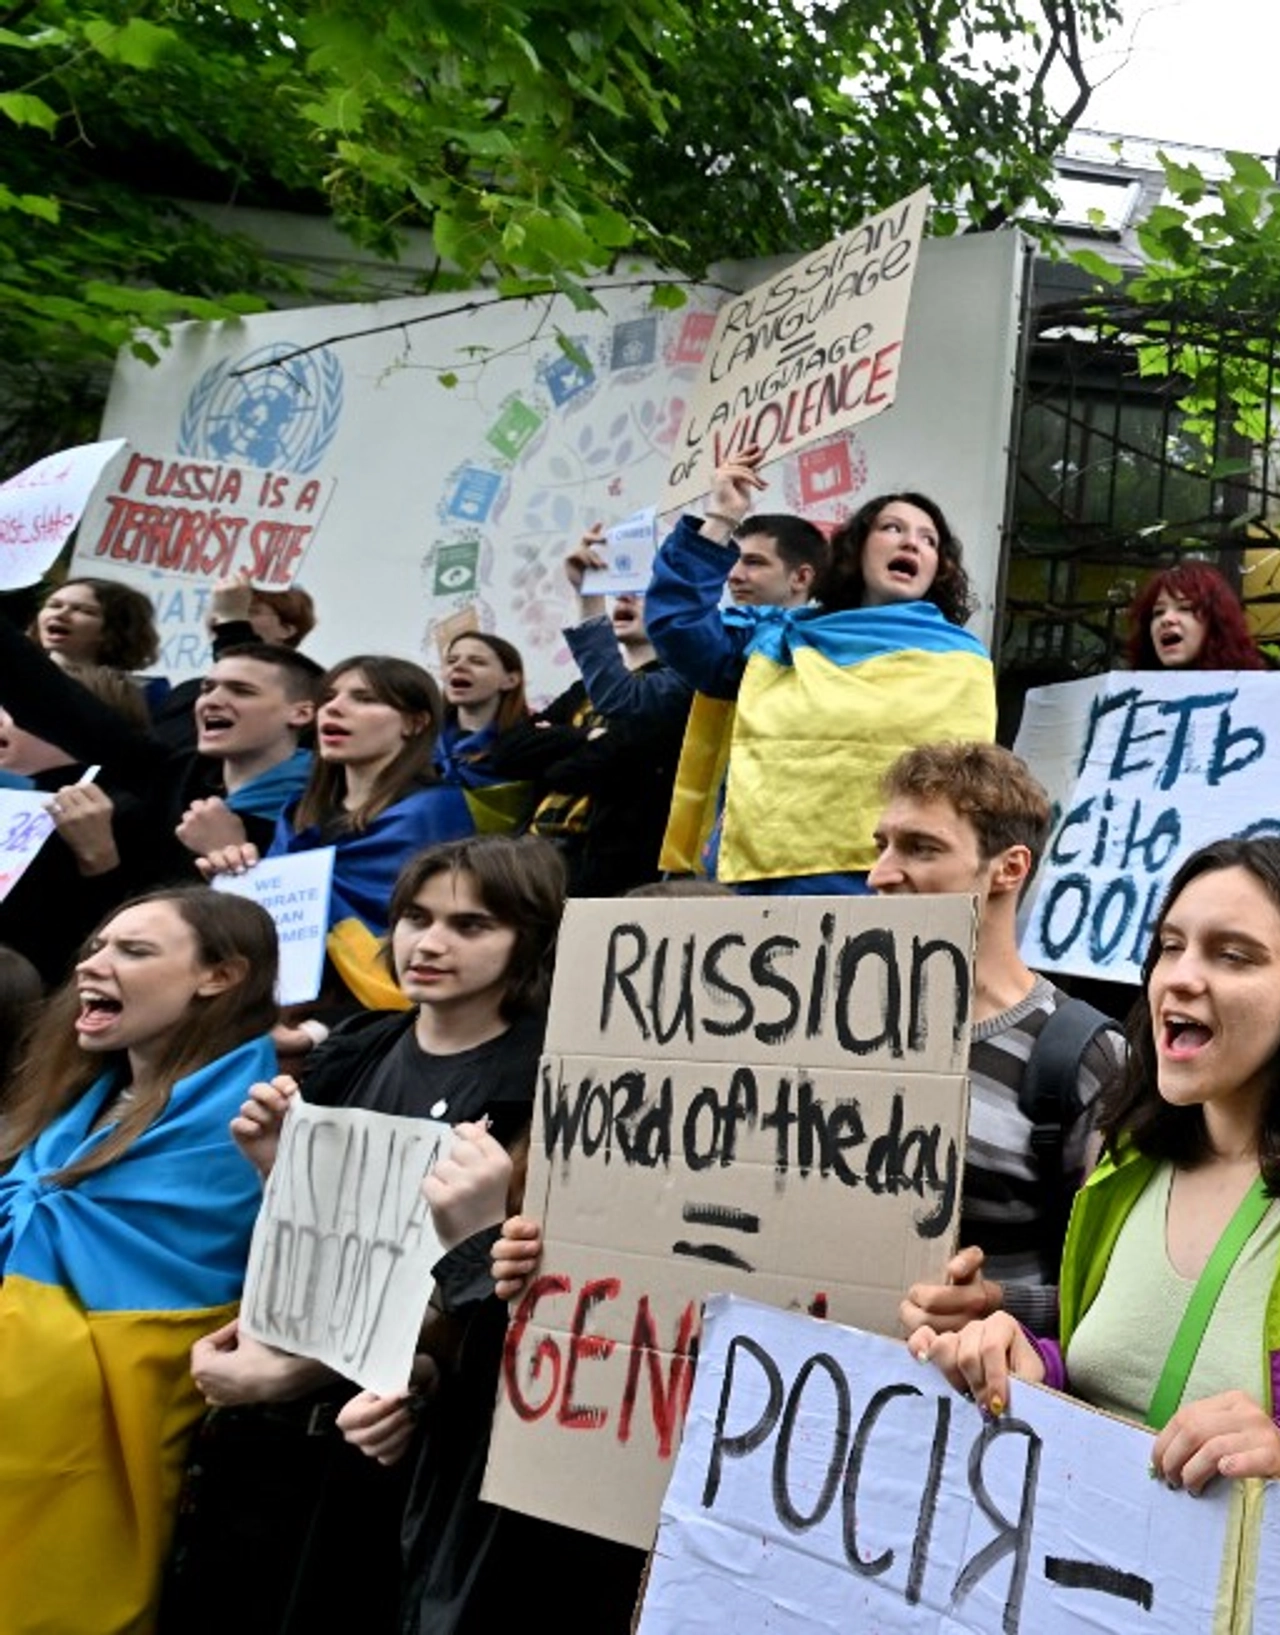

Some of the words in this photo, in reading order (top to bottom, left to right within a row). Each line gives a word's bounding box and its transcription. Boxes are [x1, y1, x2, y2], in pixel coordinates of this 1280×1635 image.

[720, 204, 911, 343] RUSSIAN
[668, 449, 703, 486] OF
[714, 340, 903, 469] VIOLENCE
[294, 479, 322, 514] A
[1076, 686, 1267, 791] ГЕТЬ
[281, 925, 319, 943] MES
[760, 1069, 868, 1190] the
[864, 1086, 958, 1239] day
